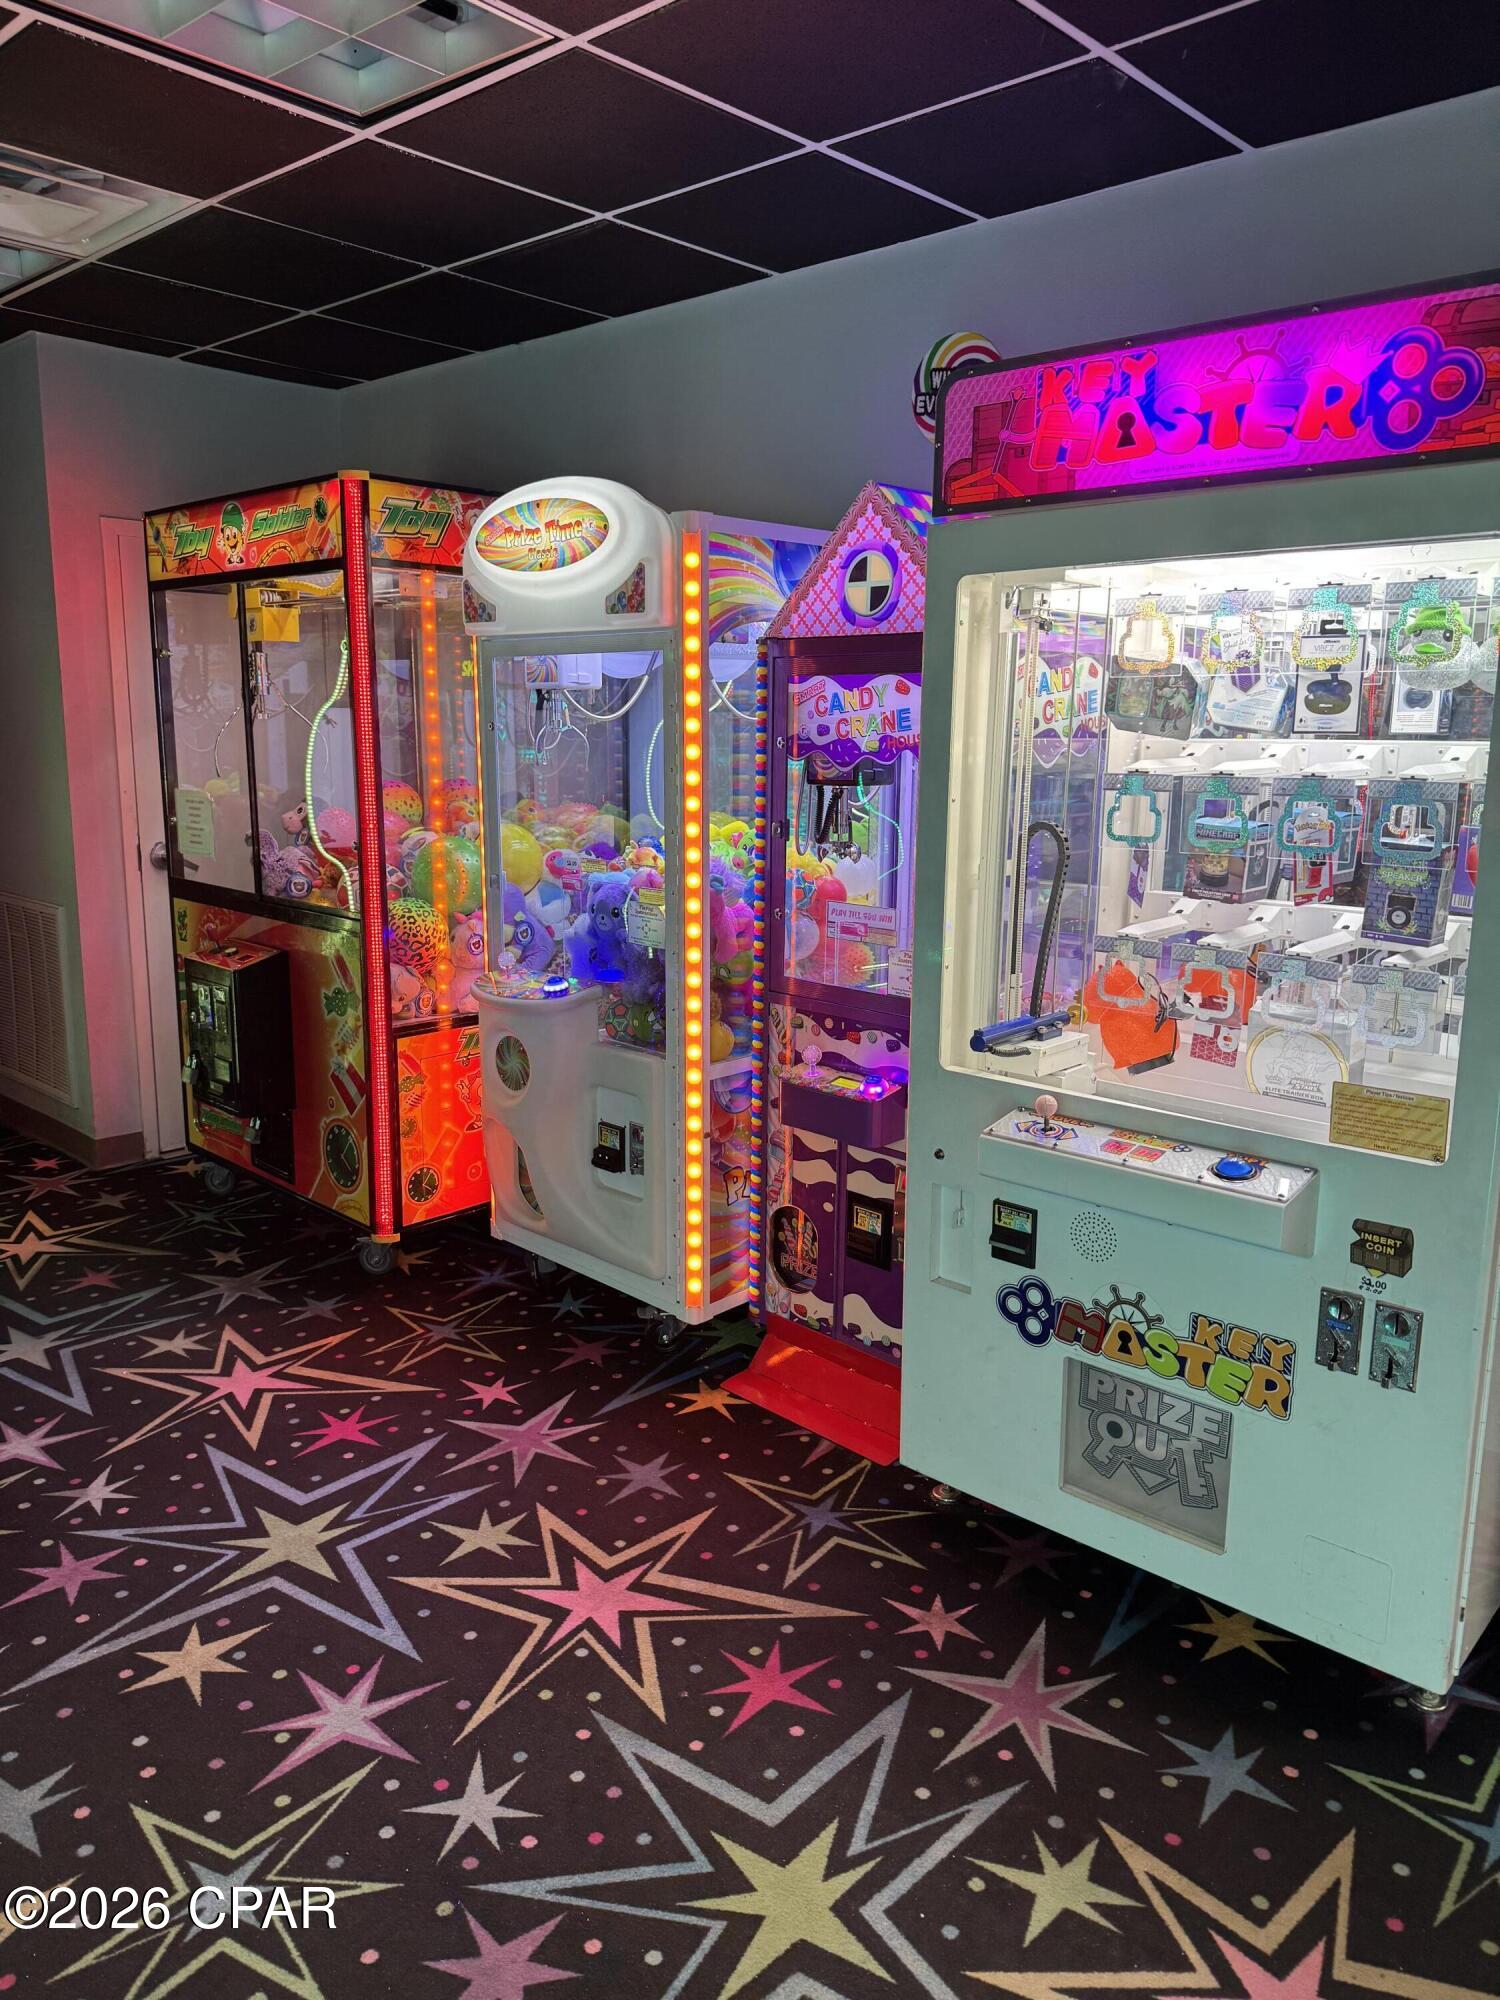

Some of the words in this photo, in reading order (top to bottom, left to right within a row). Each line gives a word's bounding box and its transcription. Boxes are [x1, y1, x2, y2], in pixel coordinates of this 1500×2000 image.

[1039, 349, 1159, 409] KEY
[1030, 372, 1360, 470] MASTER
[174, 525, 213, 560] Toy
[249, 504, 312, 542] Soldier
[378, 498, 451, 547] Toy
[504, 525, 541, 548] Prize
[545, 519, 582, 543] Time
[528, 547, 558, 559] Classic
[814, 683, 889, 717] CANDY
[1042, 690, 1098, 724] CRANE
[835, 707, 912, 739] CRANE
[1381, 870, 1423, 883] SPEAKER
[1360, 1232, 1403, 1248] INSERT
[1366, 1242, 1395, 1256] COIN
[1055, 1300, 1291, 1418] MASTER
[1194, 1315, 1295, 1371] KEY
[1087, 1367, 1224, 1447] PRIZE
[1093, 1411, 1209, 1498] OUT
